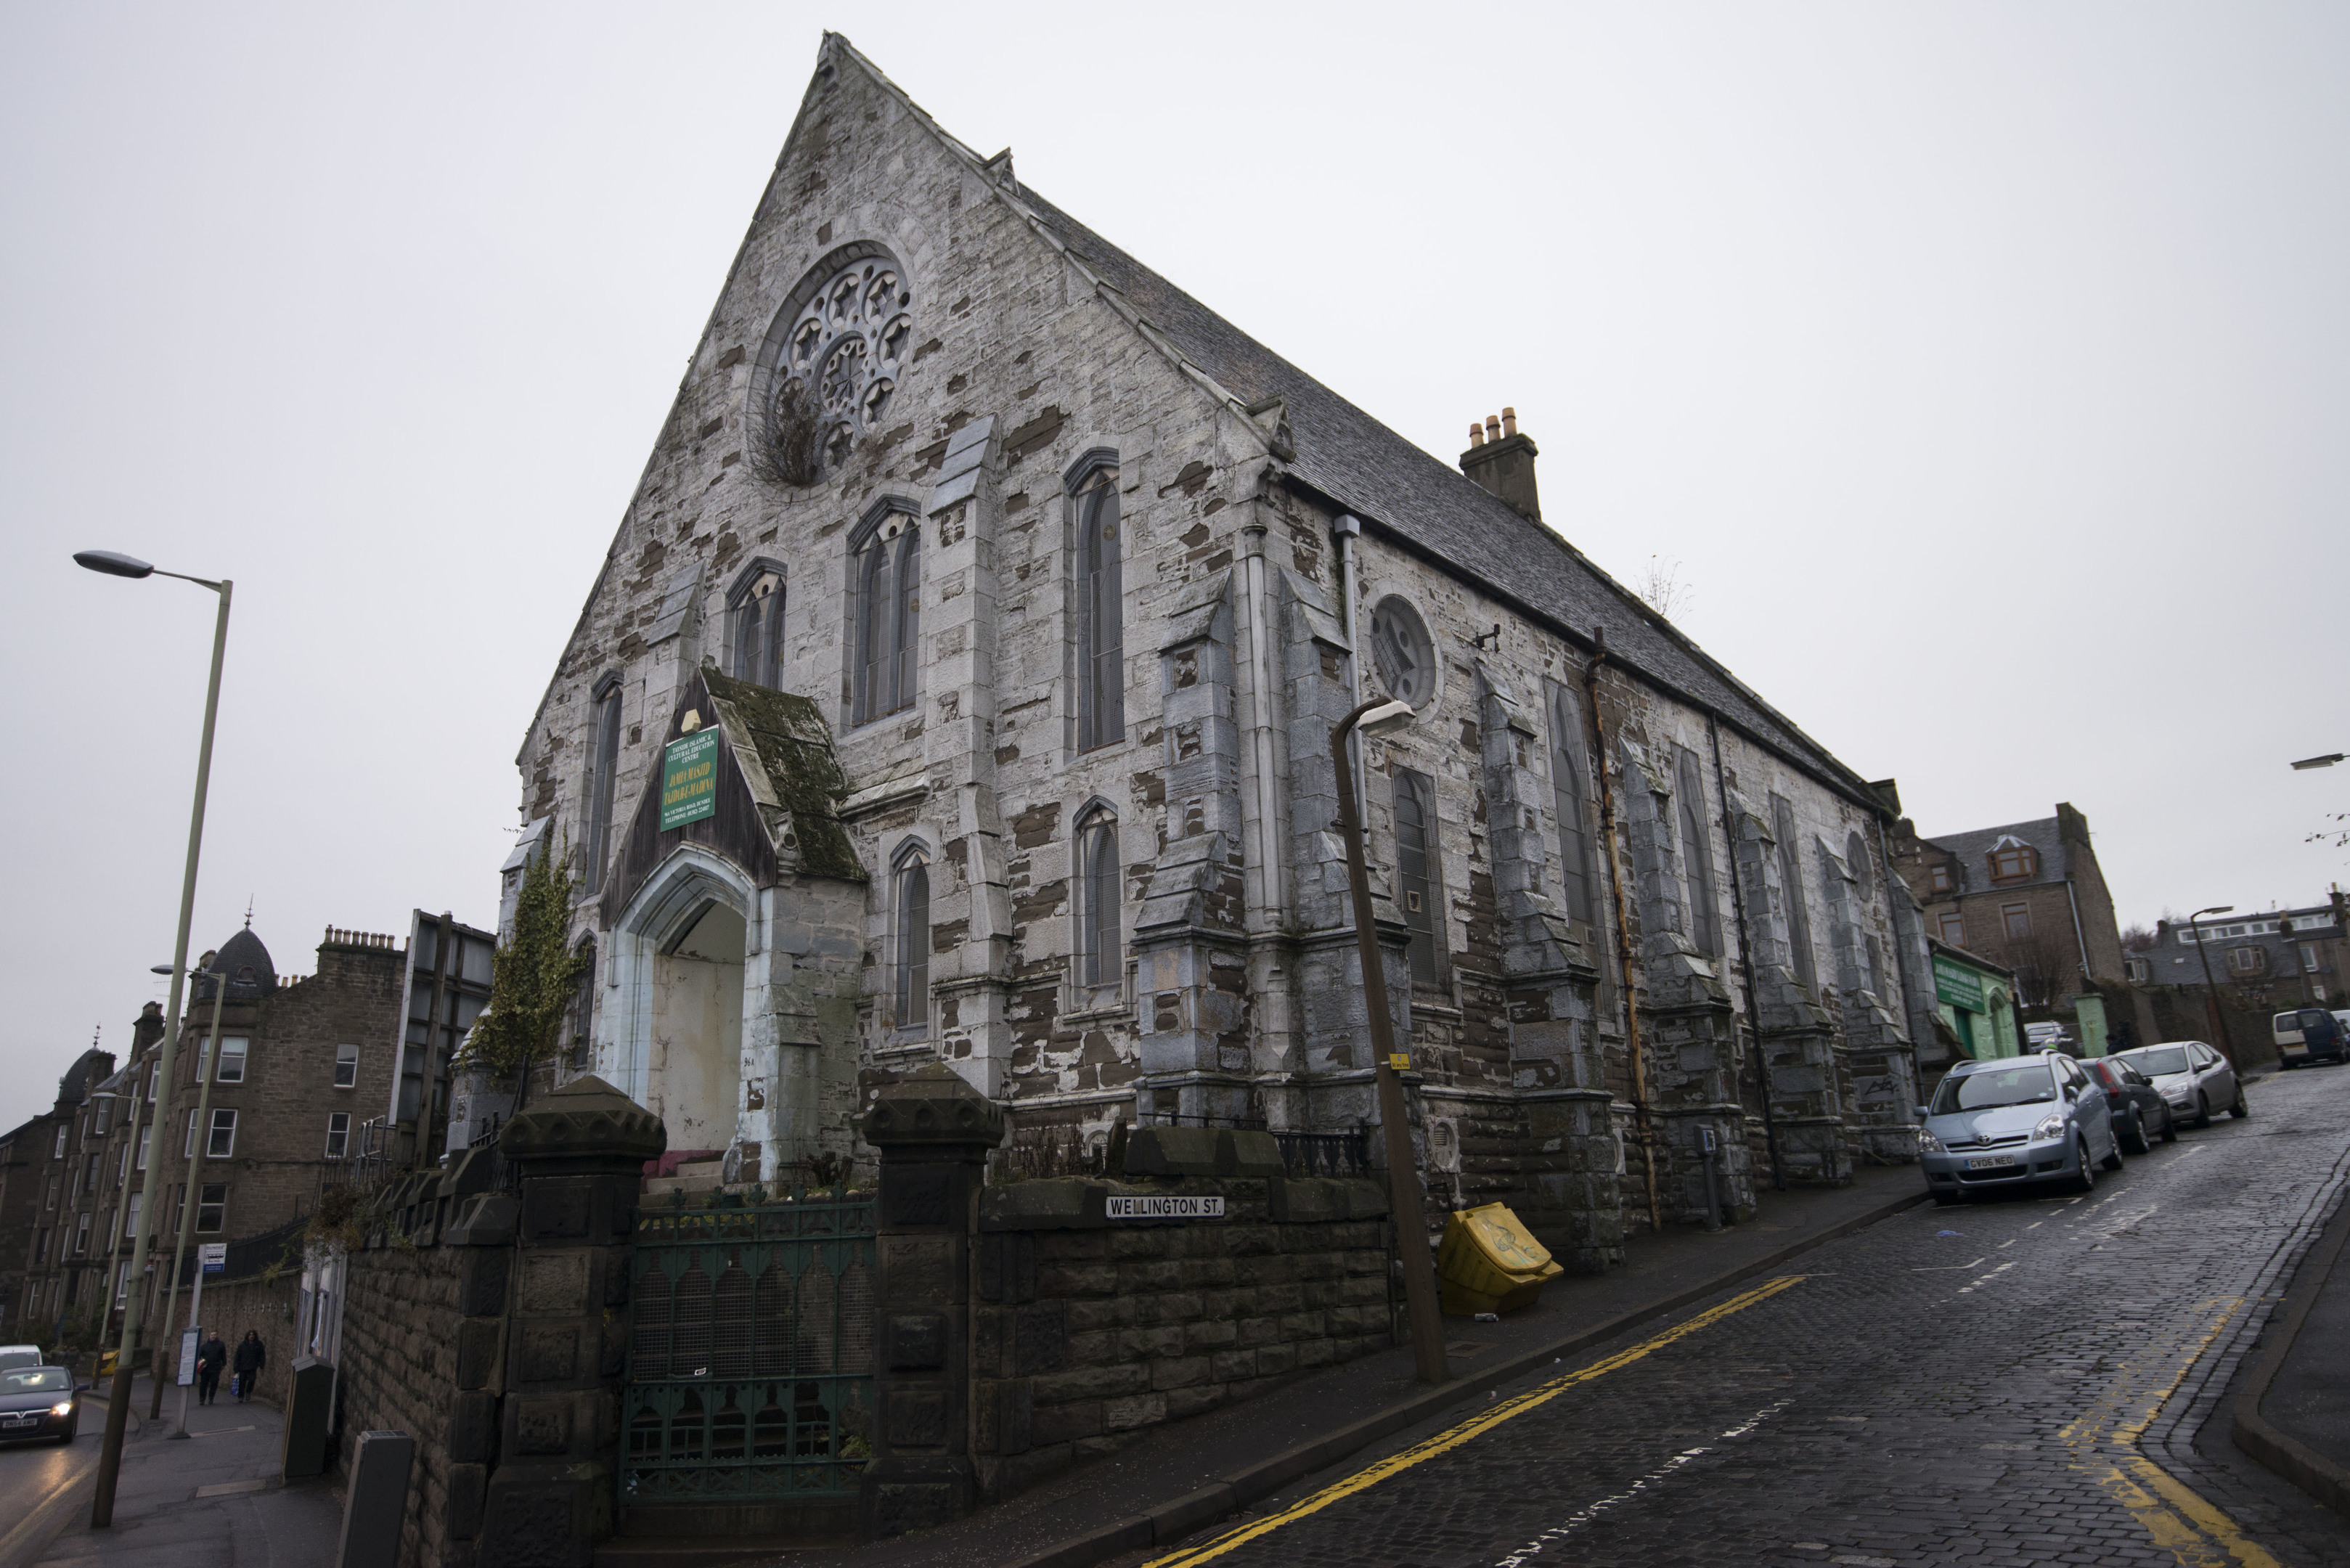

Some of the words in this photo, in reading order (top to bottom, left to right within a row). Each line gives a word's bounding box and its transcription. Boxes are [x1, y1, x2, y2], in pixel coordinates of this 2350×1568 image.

[668, 748, 690, 762] CULTURAL
[690, 739, 715, 754] EDUCATION
[672, 743, 688, 754] TAYSIDE
[689, 735, 707, 747] ISLAMIC
[682, 751, 699, 764] CENTRE
[688, 761, 710, 780] MASJID
[669, 806, 686, 815] VICTORIA
[696, 797, 711, 807] DUNDEE
[744, 1056, 755, 1067] 96A
[1970, 1158, 1994, 1168] GV06
[1994, 1156, 2013, 1167] NEO
[1110, 1199, 1198, 1215] WELLINGTON
[1203, 1199, 1221, 1214] ST.
